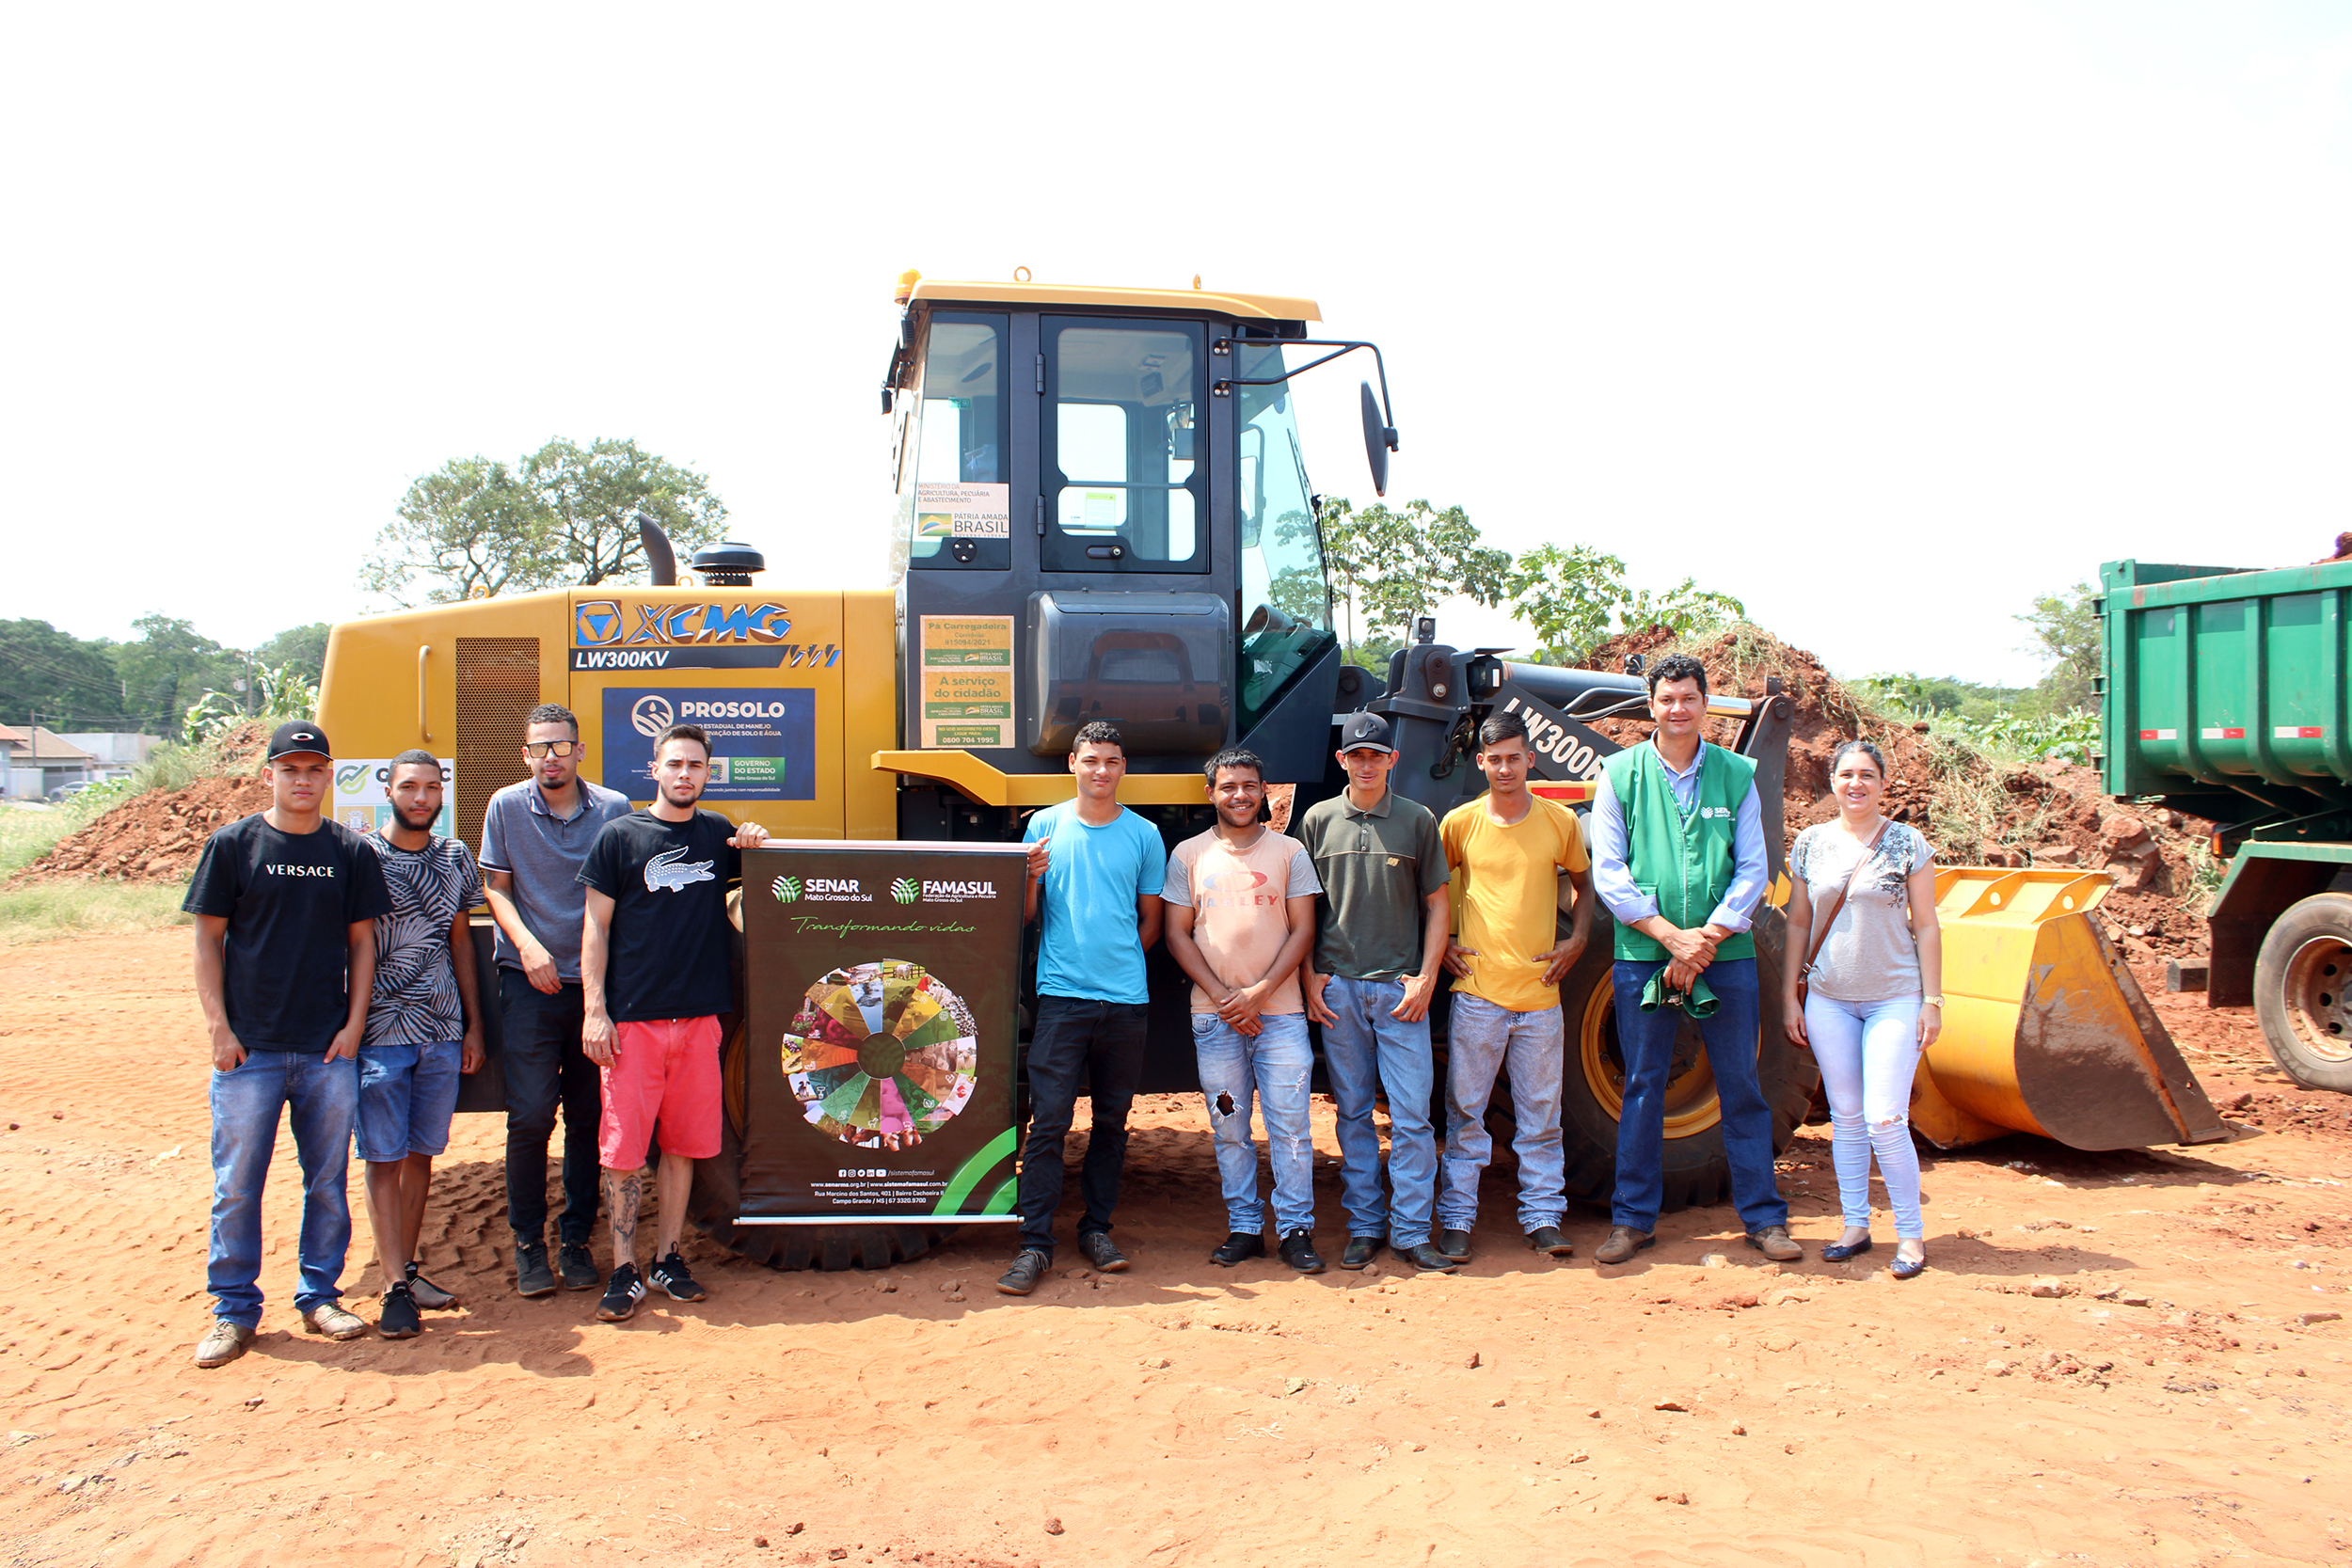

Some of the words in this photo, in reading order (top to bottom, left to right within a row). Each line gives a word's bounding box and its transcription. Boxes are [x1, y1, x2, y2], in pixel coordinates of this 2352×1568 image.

[954, 520, 1008, 533] BRASIL
[623, 603, 791, 644] XCMG
[576, 650, 669, 668] LW300KV
[940, 676, 948, 686] A
[952, 676, 995, 688] serviço
[934, 689, 949, 697] do
[953, 689, 1001, 697] cidadão
[680, 701, 786, 718] PROSOLO
[1502, 697, 1605, 781] LW300K
[265, 863, 335, 878] VERSACE
[804, 879, 860, 893] SENAR
[923, 880, 997, 895] FAMASUL
[1198, 895, 1279, 909] AKLEY
[790, 916, 927, 938] Transformando
[930, 921, 977, 932] vidas
